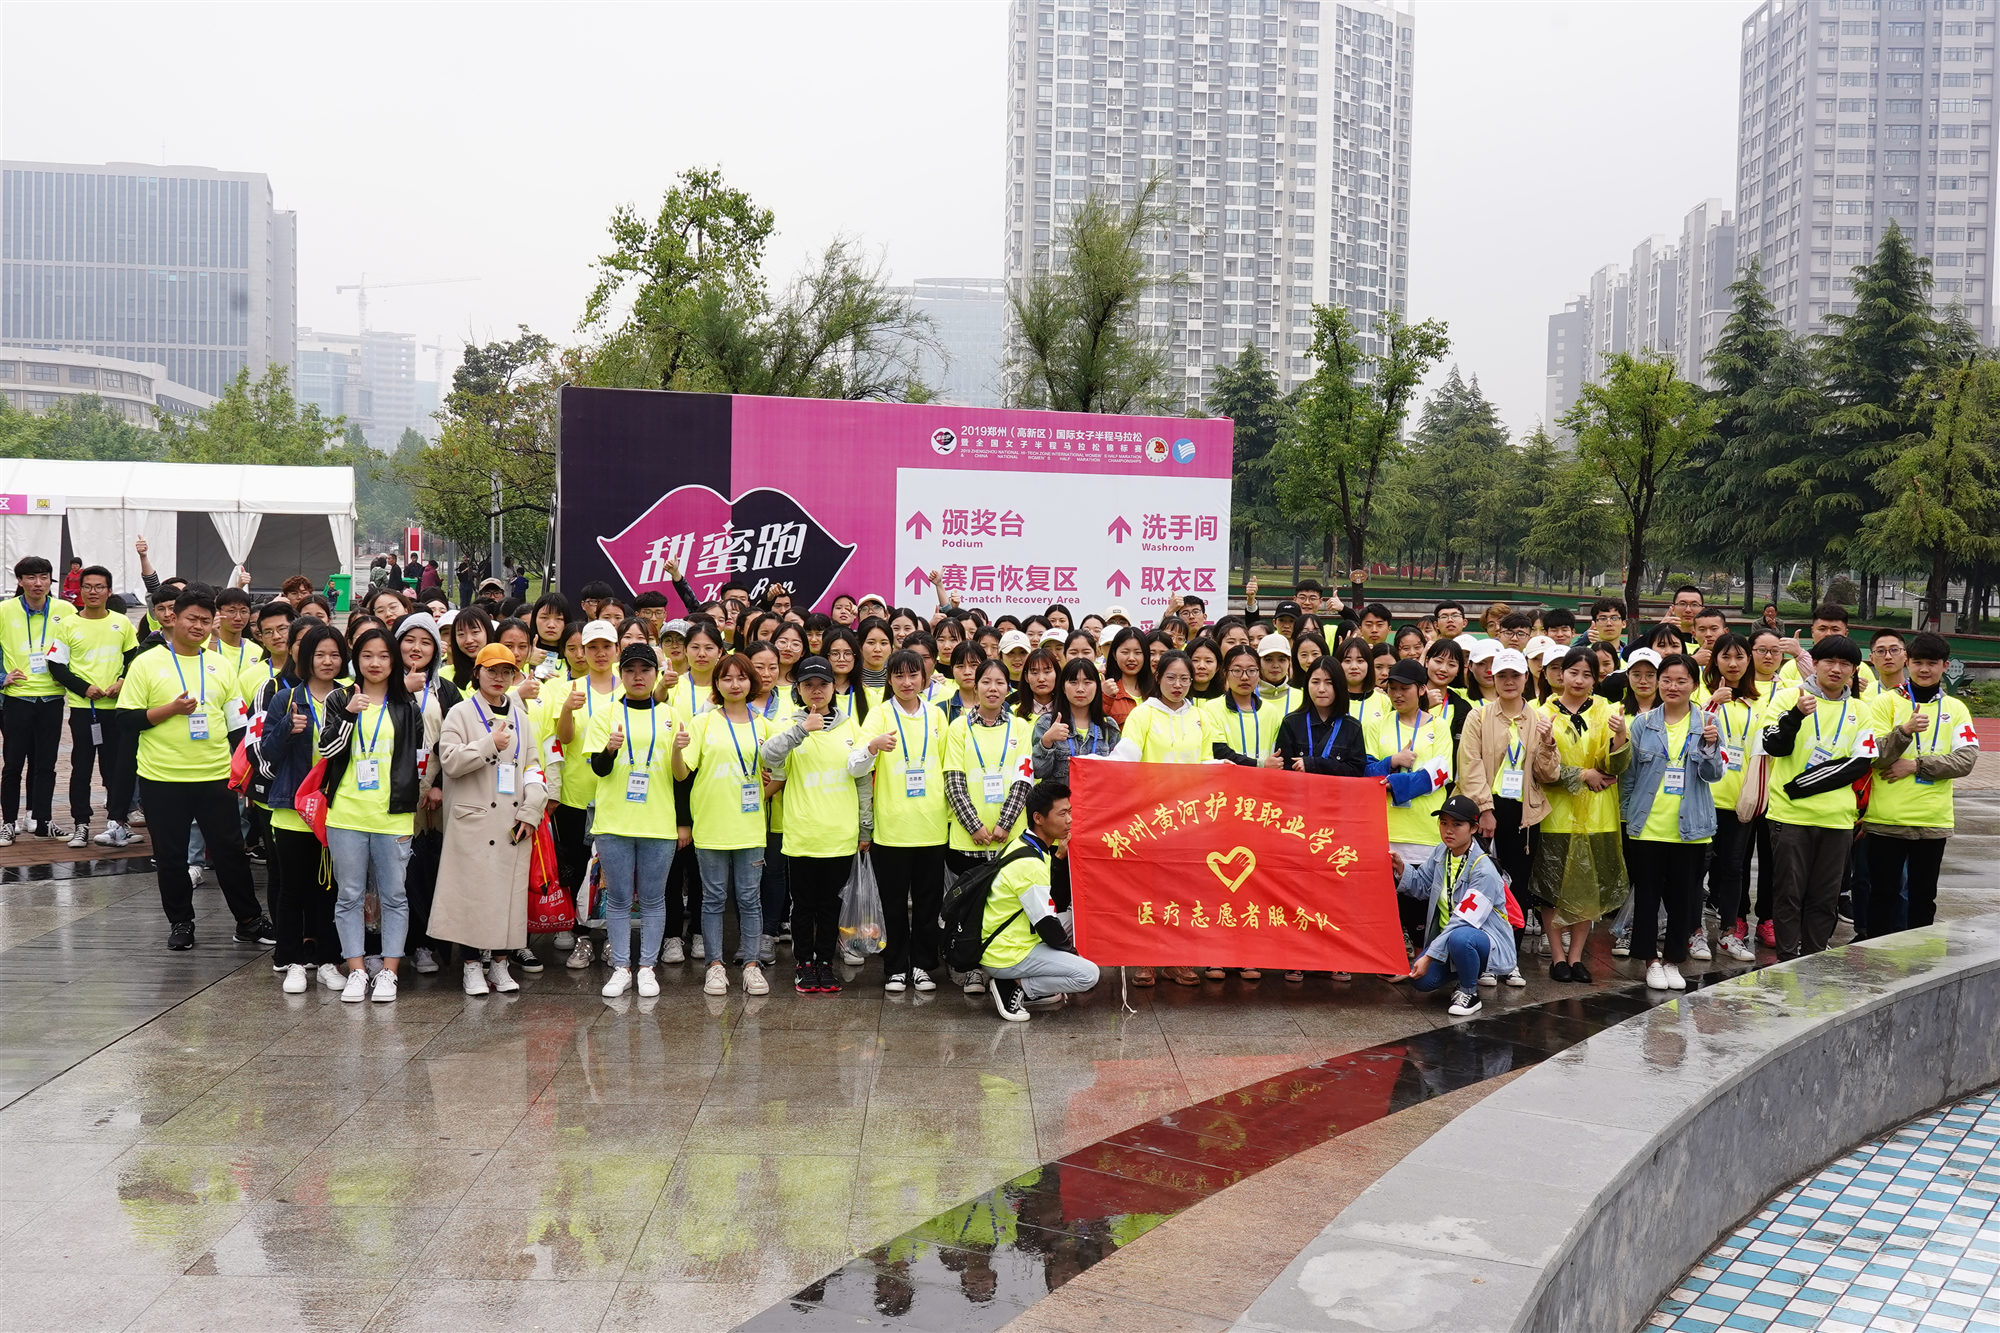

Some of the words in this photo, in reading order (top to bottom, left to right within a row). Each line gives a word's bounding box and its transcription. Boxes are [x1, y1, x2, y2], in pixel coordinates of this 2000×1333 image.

[942, 509, 1025, 537] 颁奖台
[1142, 513, 1218, 541] 洗手间
[638, 520, 808, 585] 甜蜜跑
[942, 539, 983, 548] Podium
[1142, 543, 1194, 552] Washroom
[750, 577, 796, 600] Rn
[942, 564, 1078, 592] 赛后恢复区
[1141, 566, 1216, 592] 取衣区
[1005, 595, 1052, 605] Recovery
[1056, 596, 1080, 604] Area
[1101, 791, 1359, 877] 郑州黄河护理职业学院
[1137, 899, 1341, 932] 医疗志愿者服务队
